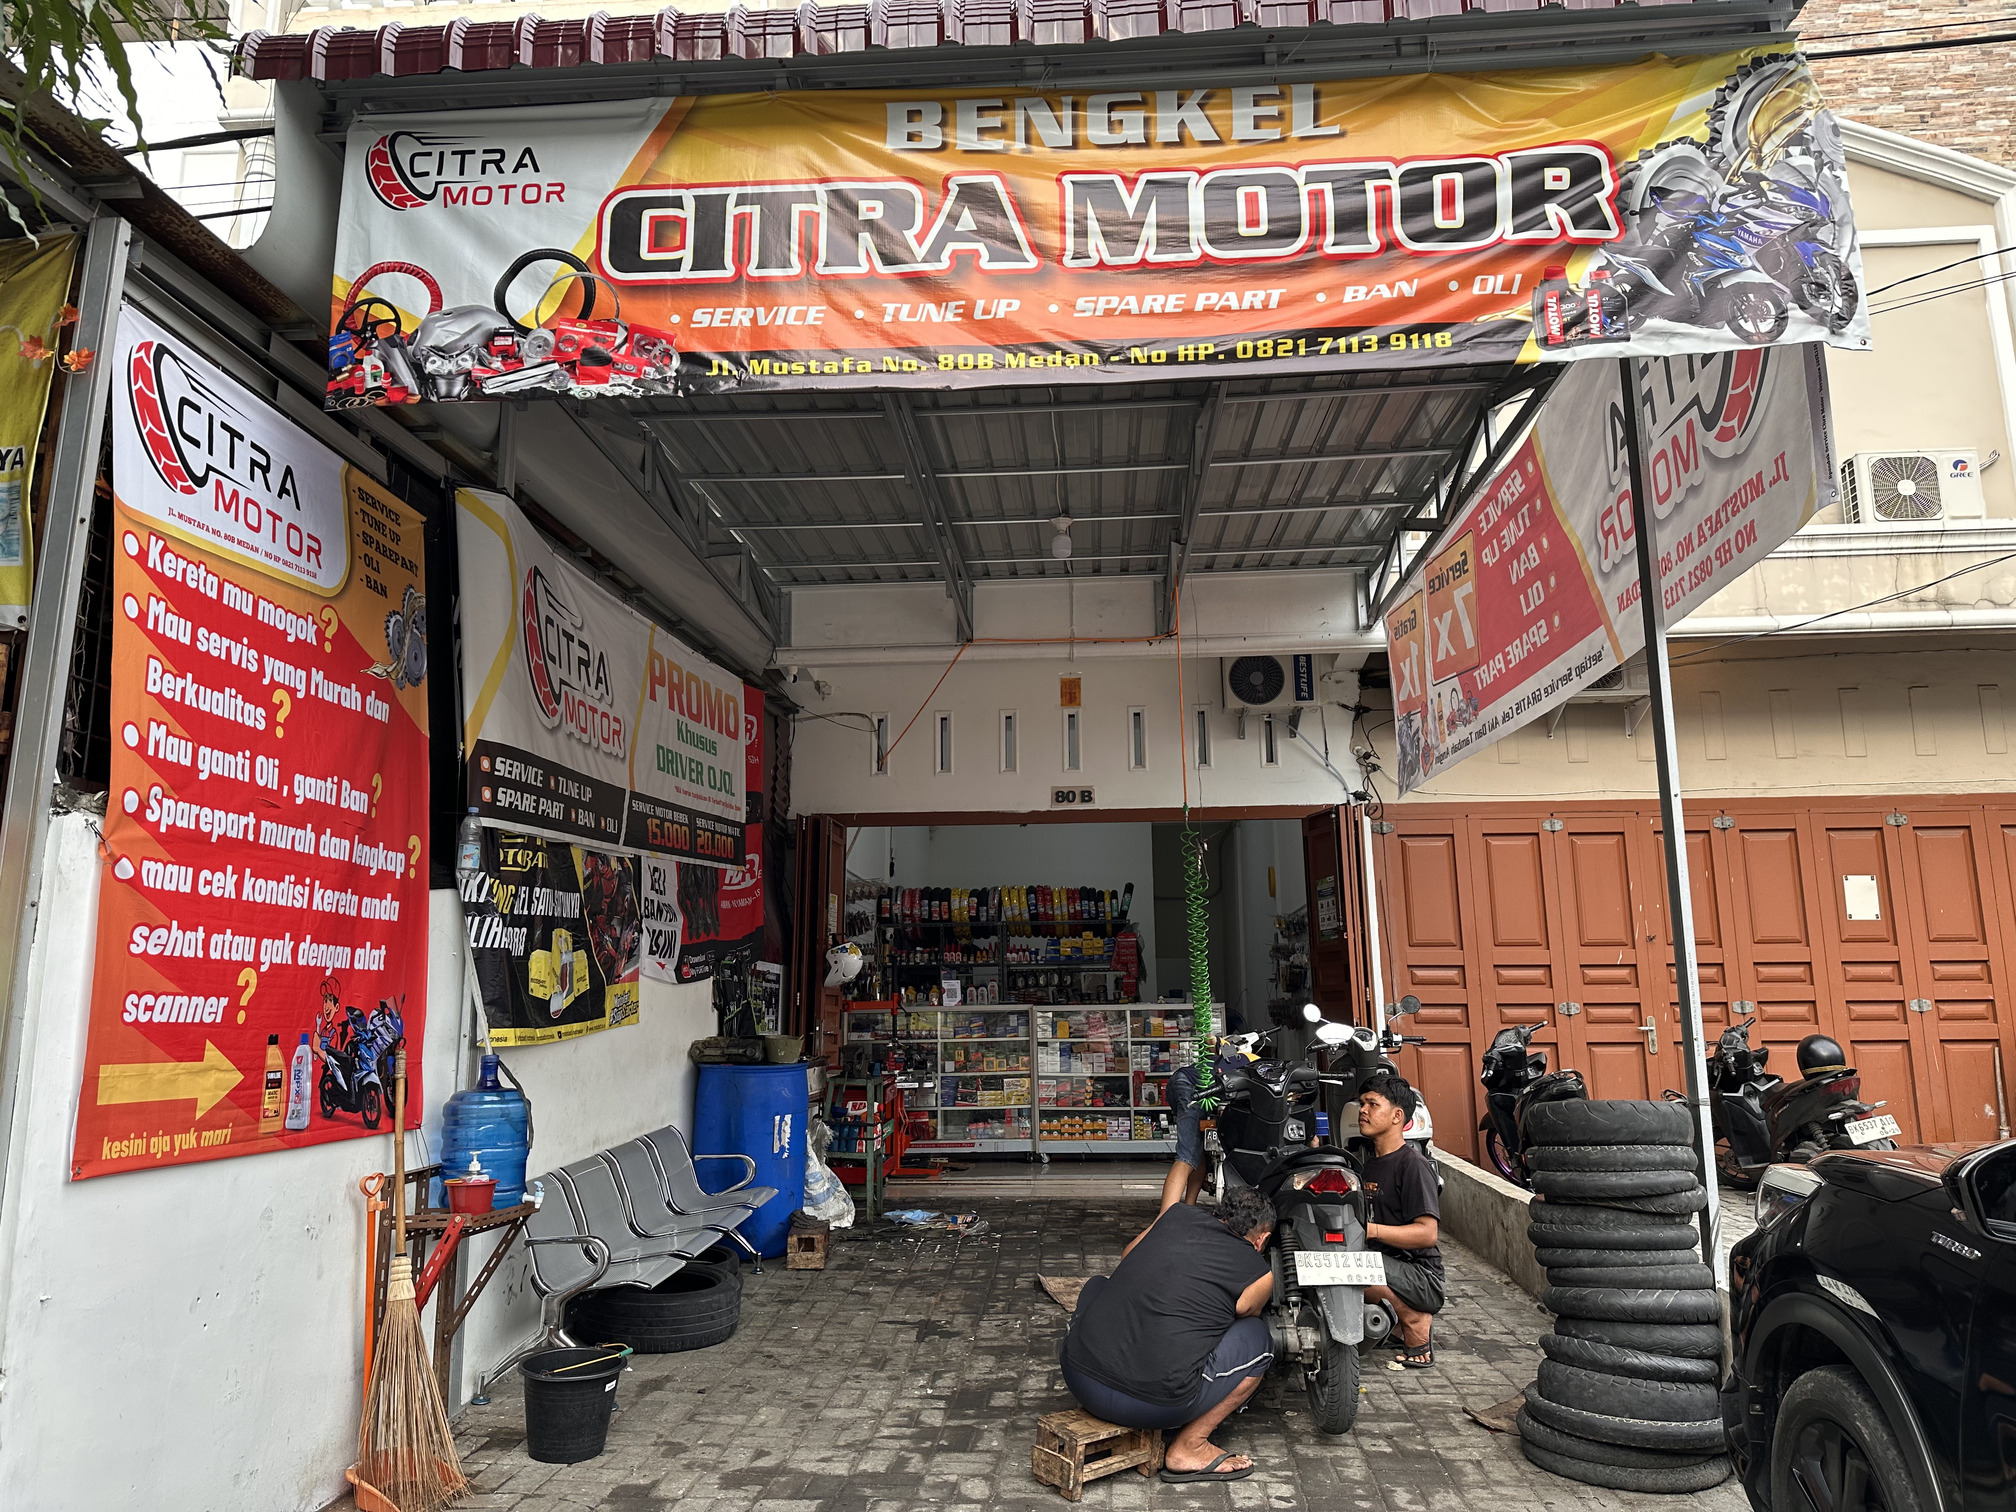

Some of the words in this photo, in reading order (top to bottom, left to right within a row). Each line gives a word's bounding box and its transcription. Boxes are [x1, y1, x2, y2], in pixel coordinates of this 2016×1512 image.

[885, 83, 1344, 152] BENGKEL
[407, 145, 541, 179] CITRA
[443, 182, 566, 210] MOTOR
[599, 172, 1040, 276] CITRA
[1060, 142, 1624, 271] MOTOR
[1737, 228, 1763, 246] YAMAHA
[1073, 293, 1187, 317] SPARE
[1194, 288, 1286, 311] PART
[1342, 278, 1418, 303] BAN
[1472, 273, 1522, 295] OLI
[690, 305, 827, 328] SERVICE
[882, 300, 963, 323] TUNE
[973, 299, 1021, 320] UP
[1547, 296, 1561, 336] MOTUL
[1588, 294, 1601, 336] MOTUL
[749, 357, 872, 376] Mustafa
[883, 355, 927, 373] No.
[938, 353, 993, 371] 80B
[1004, 350, 1100, 369] Medan
[1131, 346, 1166, 364] No
[1177, 342, 1225, 363] HP.
[1236, 338, 1306, 359] 0821
[1317, 335, 1379, 355] 7113
[1389, 331, 1453, 351] 9118
[0, 446, 25, 472] YA
[178, 396, 302, 511] CITRA
[1822, 431, 1831, 453] Service
[213, 478, 323, 570] MOTOR
[357, 486, 402, 528] SERVICE
[177, 511, 211, 535] MUSTAFA
[211, 528, 223, 540] NO.
[236, 535, 260, 554] MEDAN
[264, 550, 274, 562] NO
[273, 553, 282, 564] HP
[360, 507, 388, 535] TUNE
[388, 528, 402, 547] UP
[146, 532, 218, 600] Kereta
[222, 577, 253, 617] mu
[361, 532, 419, 579] SPAREPART
[363, 552, 381, 575] OLI
[365, 575, 389, 600] BAN
[146, 596, 193, 646] Mau
[196, 624, 258, 674] servis
[262, 653, 307, 699] yang
[310, 667, 362, 712] Murah
[365, 690, 391, 724] dan
[544, 613, 610, 697] CITRA
[146, 657, 267, 731] Berkualitas
[649, 649, 740, 741] PROMO
[1299, 655, 1309, 699] BESTLIFE
[563, 689, 623, 752] MOTOR
[676, 718, 717, 757] Khusus
[146, 720, 194, 768] Mau
[197, 743, 251, 783] ganti
[254, 754, 280, 791] Oli
[293, 771, 339, 805] ganti
[494, 756, 544, 788] SERVICE
[656, 743, 704, 787] DRIVER
[707, 764, 736, 798] OJOL
[496, 787, 537, 815] SPARE
[538, 798, 565, 821] PART
[558, 776, 580, 800] TUNE
[580, 786, 593, 803] UP
[1055, 790, 1077, 803] 80
[1080, 790, 1093, 803] B
[145, 784, 256, 844] Sparepart
[259, 813, 315, 857] murah
[319, 828, 350, 862] dan
[578, 808, 596, 829] BAN
[606, 817, 618, 834] OLI
[631, 800, 655, 816] SERVICE
[655, 806, 673, 820] MOTOR
[673, 811, 689, 825] BEBEK
[695, 817, 715, 831] SERVICE
[646, 817, 690, 851] 15.000
[696, 829, 734, 860] 20.000
[141, 857, 192, 894] mau
[197, 863, 238, 899] cek
[241, 866, 310, 910] kondisi
[312, 879, 359, 917] kereta
[360, 891, 400, 923] anda
[129, 918, 206, 958] sehat
[208, 926, 255, 962] atau
[259, 931, 294, 973] gak
[297, 937, 351, 976] dengan
[353, 941, 387, 972] alat
[122, 990, 229, 1025] scanner
[102, 1132, 147, 1160] kesini
[149, 1130, 171, 1158] aja
[173, 1127, 198, 1153] yuk
[200, 1121, 233, 1147] mari
